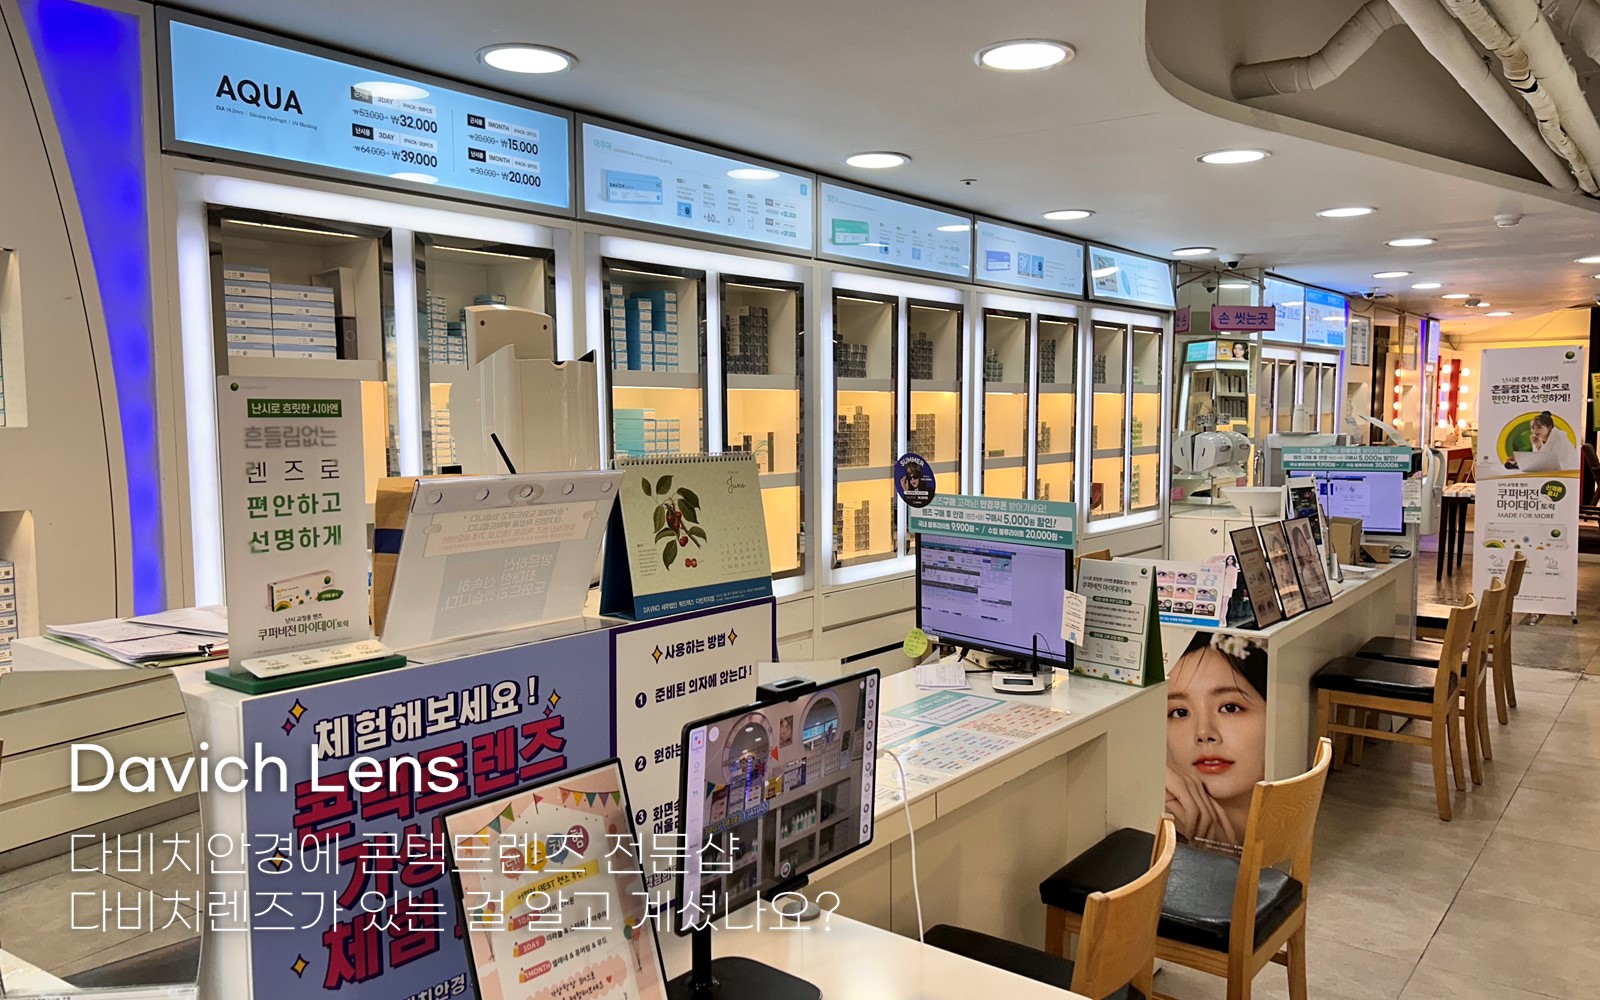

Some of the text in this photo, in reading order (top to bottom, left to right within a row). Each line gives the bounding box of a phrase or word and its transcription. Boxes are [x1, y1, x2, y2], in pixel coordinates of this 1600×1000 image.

[215, 74, 304, 115] AQUA
[377, 96, 394, 105] 3DAY
[249, 111, 266, 120] Silicone
[267, 115, 287, 124] Hydrogel
[299, 122, 318, 131] Blocking
[487, 121, 510, 132] 1MONTH
[354, 126, 395, 141] 난시용 3DAY
[489, 154, 511, 165] 1MONTH
[1218, 312, 1230, 325] 손
[1234, 311, 1270, 326] 씻는곳
[1490, 383, 1570, 395] 흔들림없는 렌즈로
[251, 402, 339, 414] 난시로 흐릿한 시야엔
[1491, 393, 1571, 405] 편안하고 선명하게!
[243, 424, 338, 449] 흔들림없는
[899, 456, 925, 468] SUMMER
[726, 476, 746, 494] June
[1497, 489, 1539, 501] 쿠퍼비전
[247, 492, 341, 519] 편안하고
[957, 498, 979, 508] 고객님!
[980, 500, 1007, 510] 안경쿠폰
[1008, 502, 1047, 513] 받아가세요!
[1497, 500, 1556, 511] 마이데이 토릭
[934, 509, 945, 518] 구매
[945, 510, 952, 518] 후
[952, 511, 964, 520] 안경
[985, 513, 1003, 523] 구매시
[1003, 514, 1035, 527] 5,000원
[1036, 517, 1057, 529] 할인!
[927, 521, 950, 530] 블루라이트
[987, 527, 998, 535] 수입
[998, 528, 1025, 538] 블루라이트
[248, 524, 342, 554] 선명하게
[296, 614, 312, 622] 교정용
[258, 619, 350, 641] 쿠퍼비전 마이데이 토릭
[664, 632, 726, 661] 사용하는 방법
[655, 681, 686, 704] 준비된
[688, 673, 718, 695] 의자에
[719, 665, 753, 685] 앉는다!
[314, 675, 540, 762] 체험해보세요!
[654, 743, 682, 765] 원하는
[293, 715, 567, 845] 콘택트렌즈
[336, 818, 450, 910] 가상
[537, 879, 555, 892] BEST
[557, 874, 570, 886] 렌즈
[323, 888, 446, 990] 체험
[521, 939, 541, 954] 3DAY
[524, 962, 551, 980] 1MONTH
